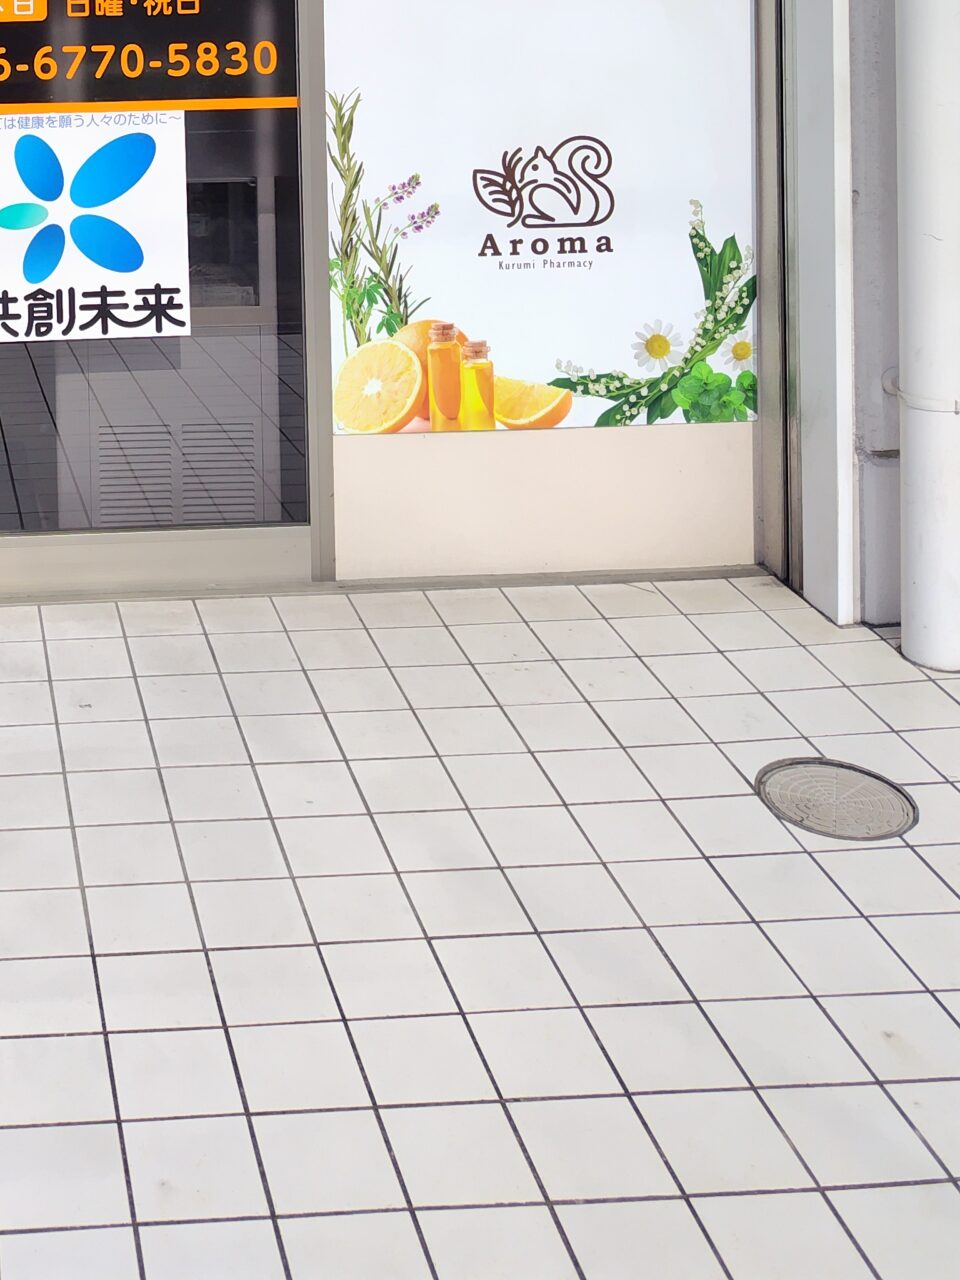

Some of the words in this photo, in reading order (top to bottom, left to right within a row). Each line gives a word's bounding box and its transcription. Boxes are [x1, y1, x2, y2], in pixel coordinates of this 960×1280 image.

[477, 233, 614, 257] Aroma
[498, 259, 536, 270] Kurumi
[543, 258, 594, 271] Pharmacy
